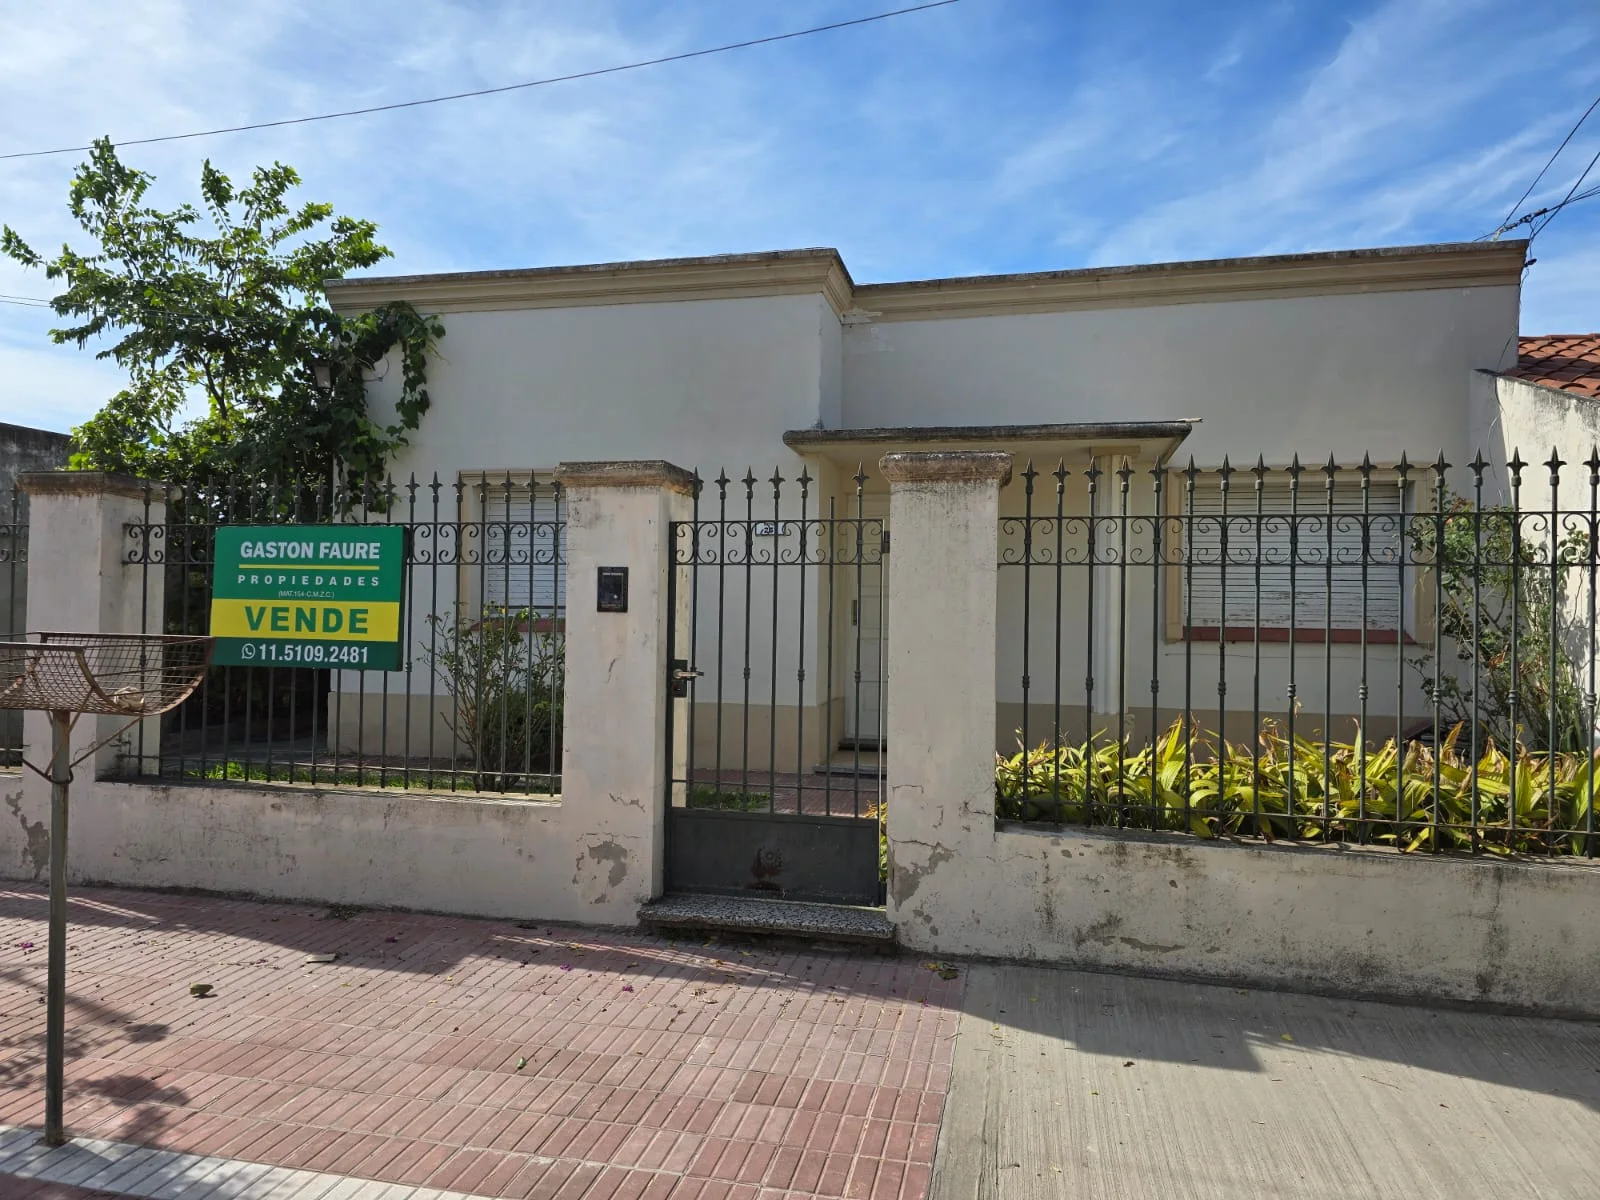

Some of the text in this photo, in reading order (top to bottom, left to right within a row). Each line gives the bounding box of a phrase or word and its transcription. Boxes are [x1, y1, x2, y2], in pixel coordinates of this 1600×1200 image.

[240, 541, 381, 559] GASTON FAURE
[238, 575, 379, 586] PROPIEDADES
[244, 606, 369, 634] VENDE
[259, 643, 368, 664] 11.5109.2481
